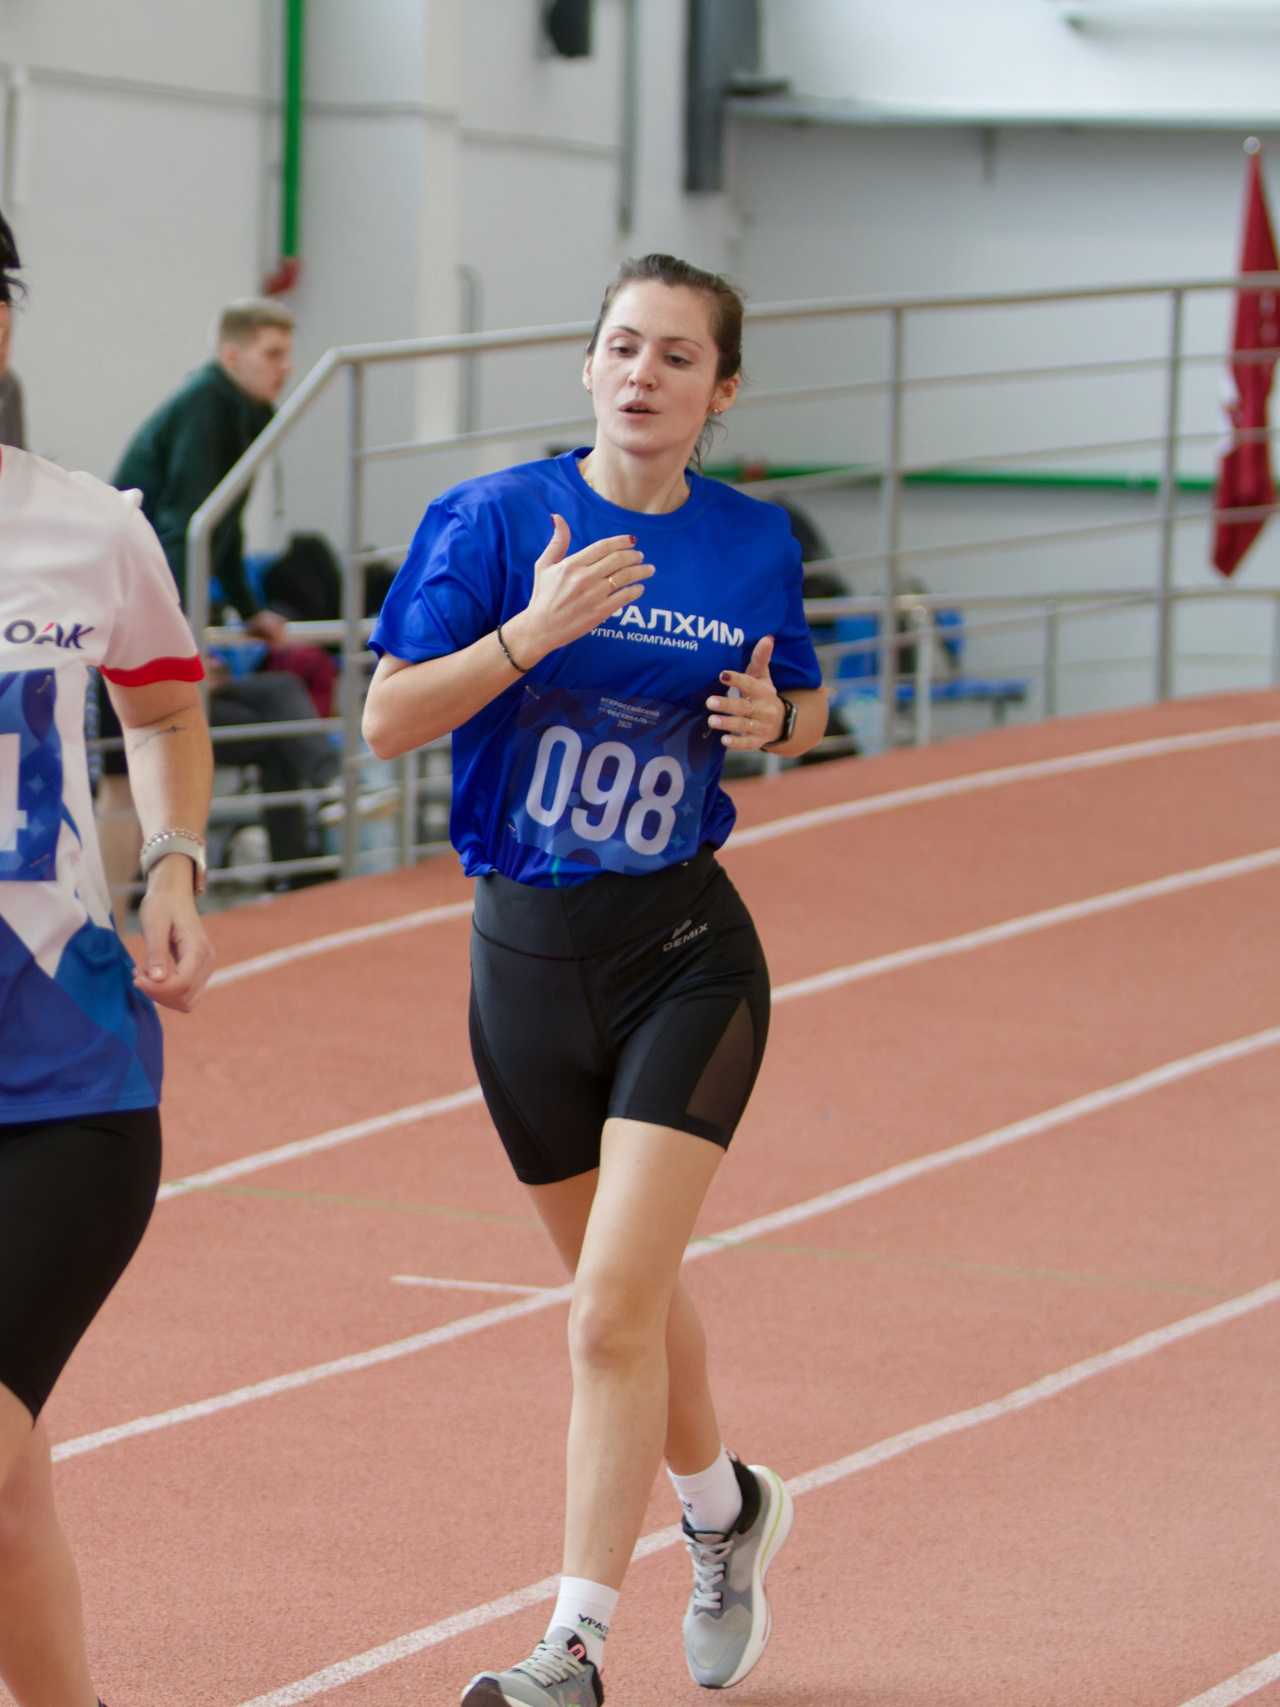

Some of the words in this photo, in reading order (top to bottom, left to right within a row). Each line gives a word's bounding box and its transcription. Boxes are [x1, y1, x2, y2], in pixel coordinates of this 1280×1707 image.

[590, 627, 625, 640] УППА
[626, 631, 699, 652] КОМПАНИЙ
[526, 724, 685, 856] 098
[662, 922, 709, 952] DEMIX
